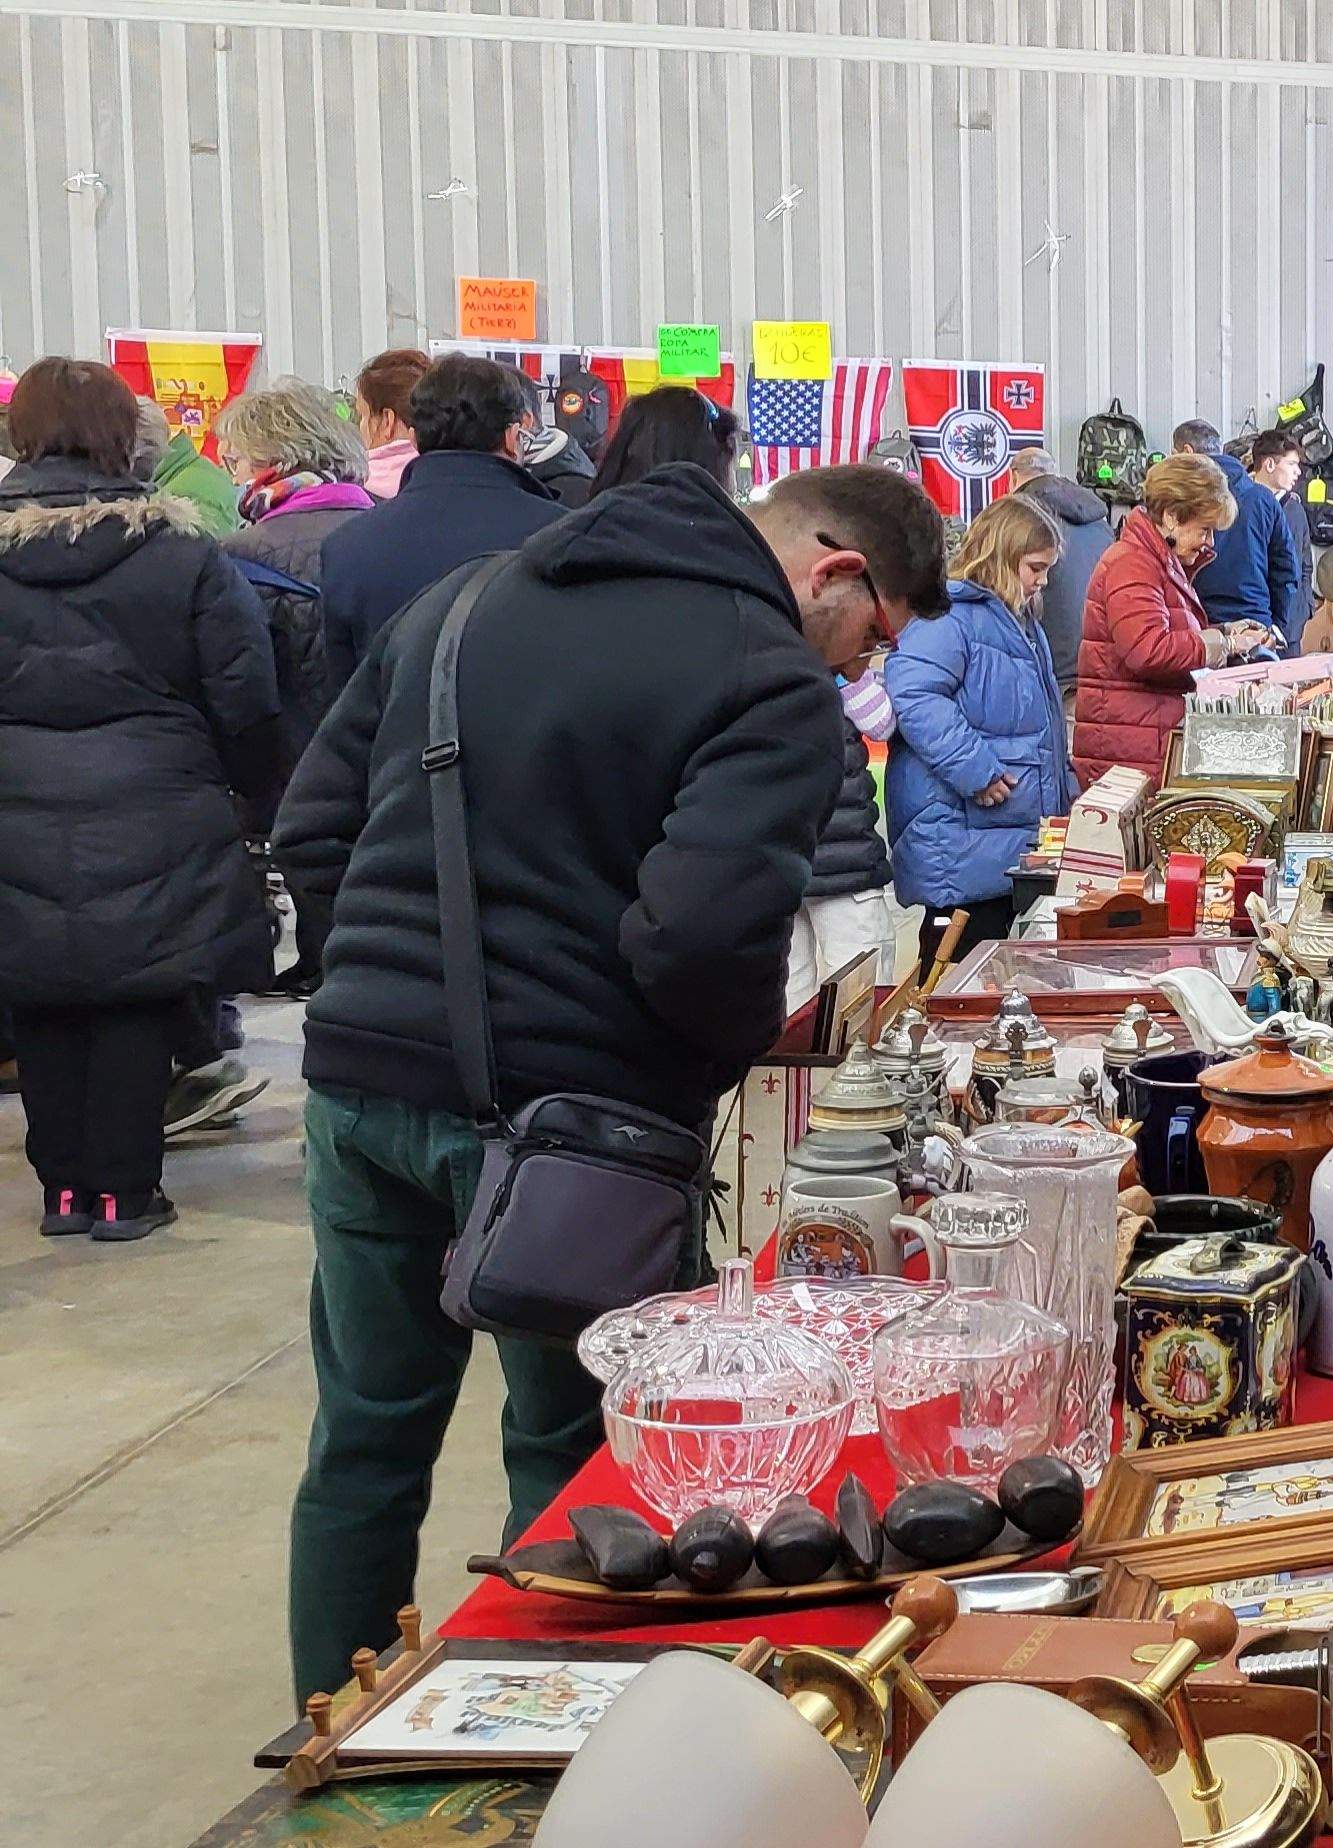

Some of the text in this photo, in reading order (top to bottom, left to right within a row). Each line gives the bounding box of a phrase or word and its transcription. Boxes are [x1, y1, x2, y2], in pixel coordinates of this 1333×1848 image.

[463, 301, 528, 313] MILITARIA
[673, 326, 716, 337] COMPRA
[660, 338, 688, 348] ROPA
[660, 347, 711, 359] MILITAR
[769, 341, 818, 365] 10€
[817, 1202, 829, 1214] de
